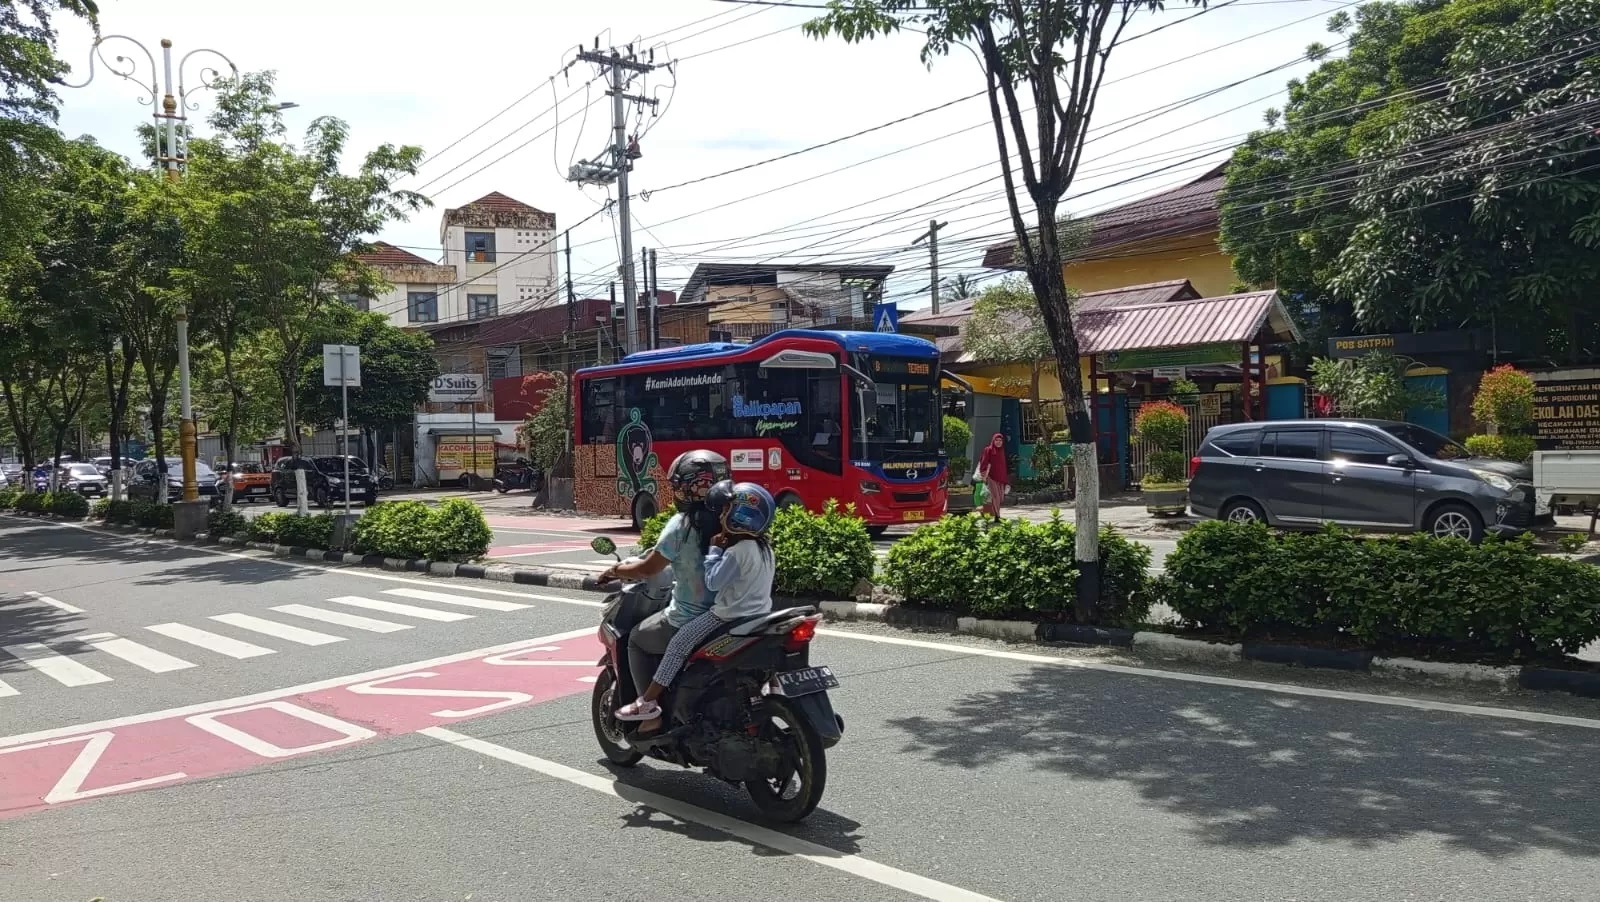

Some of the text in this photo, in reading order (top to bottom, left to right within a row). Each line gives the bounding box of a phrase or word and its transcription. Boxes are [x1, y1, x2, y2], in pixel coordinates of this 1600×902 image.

[435, 377, 477, 389] D'Suits
[645, 373, 722, 391] #KamiAdaUntukAnda
[732, 394, 802, 420] Balikpapan
[1532, 405, 1600, 419] EKOLAH DAS
